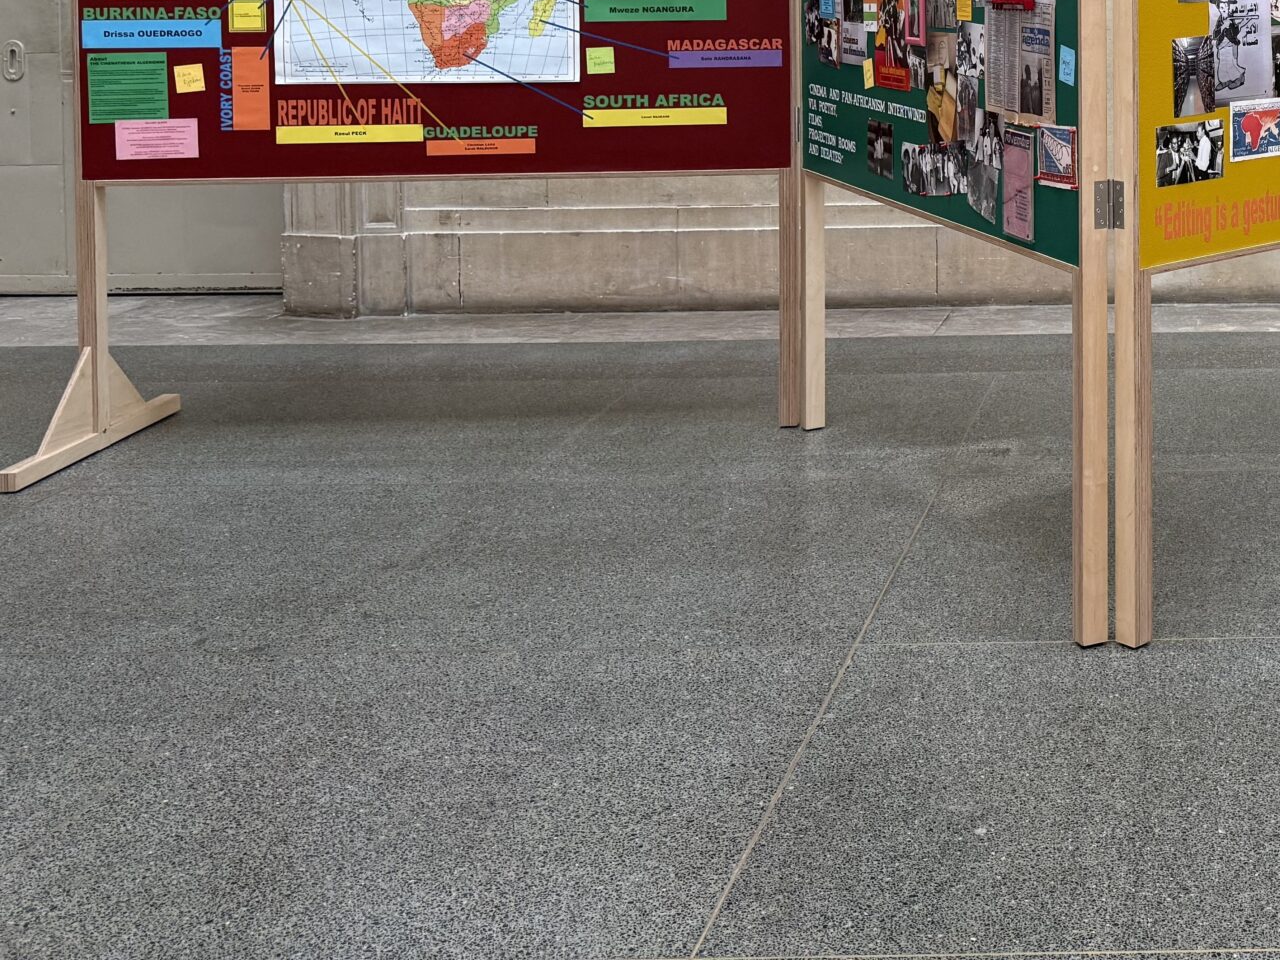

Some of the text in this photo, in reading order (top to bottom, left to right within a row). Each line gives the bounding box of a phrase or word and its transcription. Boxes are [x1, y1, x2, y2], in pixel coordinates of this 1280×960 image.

[82, 7, 222, 20] BURKINA-FASO
[609, 6, 694, 14] Mweze NGANGURA
[103, 29, 203, 38] Drissa OUEDRAOGO
[667, 39, 783, 51] MADAGASCAR
[219, 47, 233, 131] IVORY COAST
[583, 93, 725, 108] SOUTH AFRICA
[277, 98, 422, 126] REPUBLIC OF HAITI
[423, 126, 538, 139] GUADELOUPE
[1216, 200, 1226, 231] is
[1231, 204, 1239, 227] a
